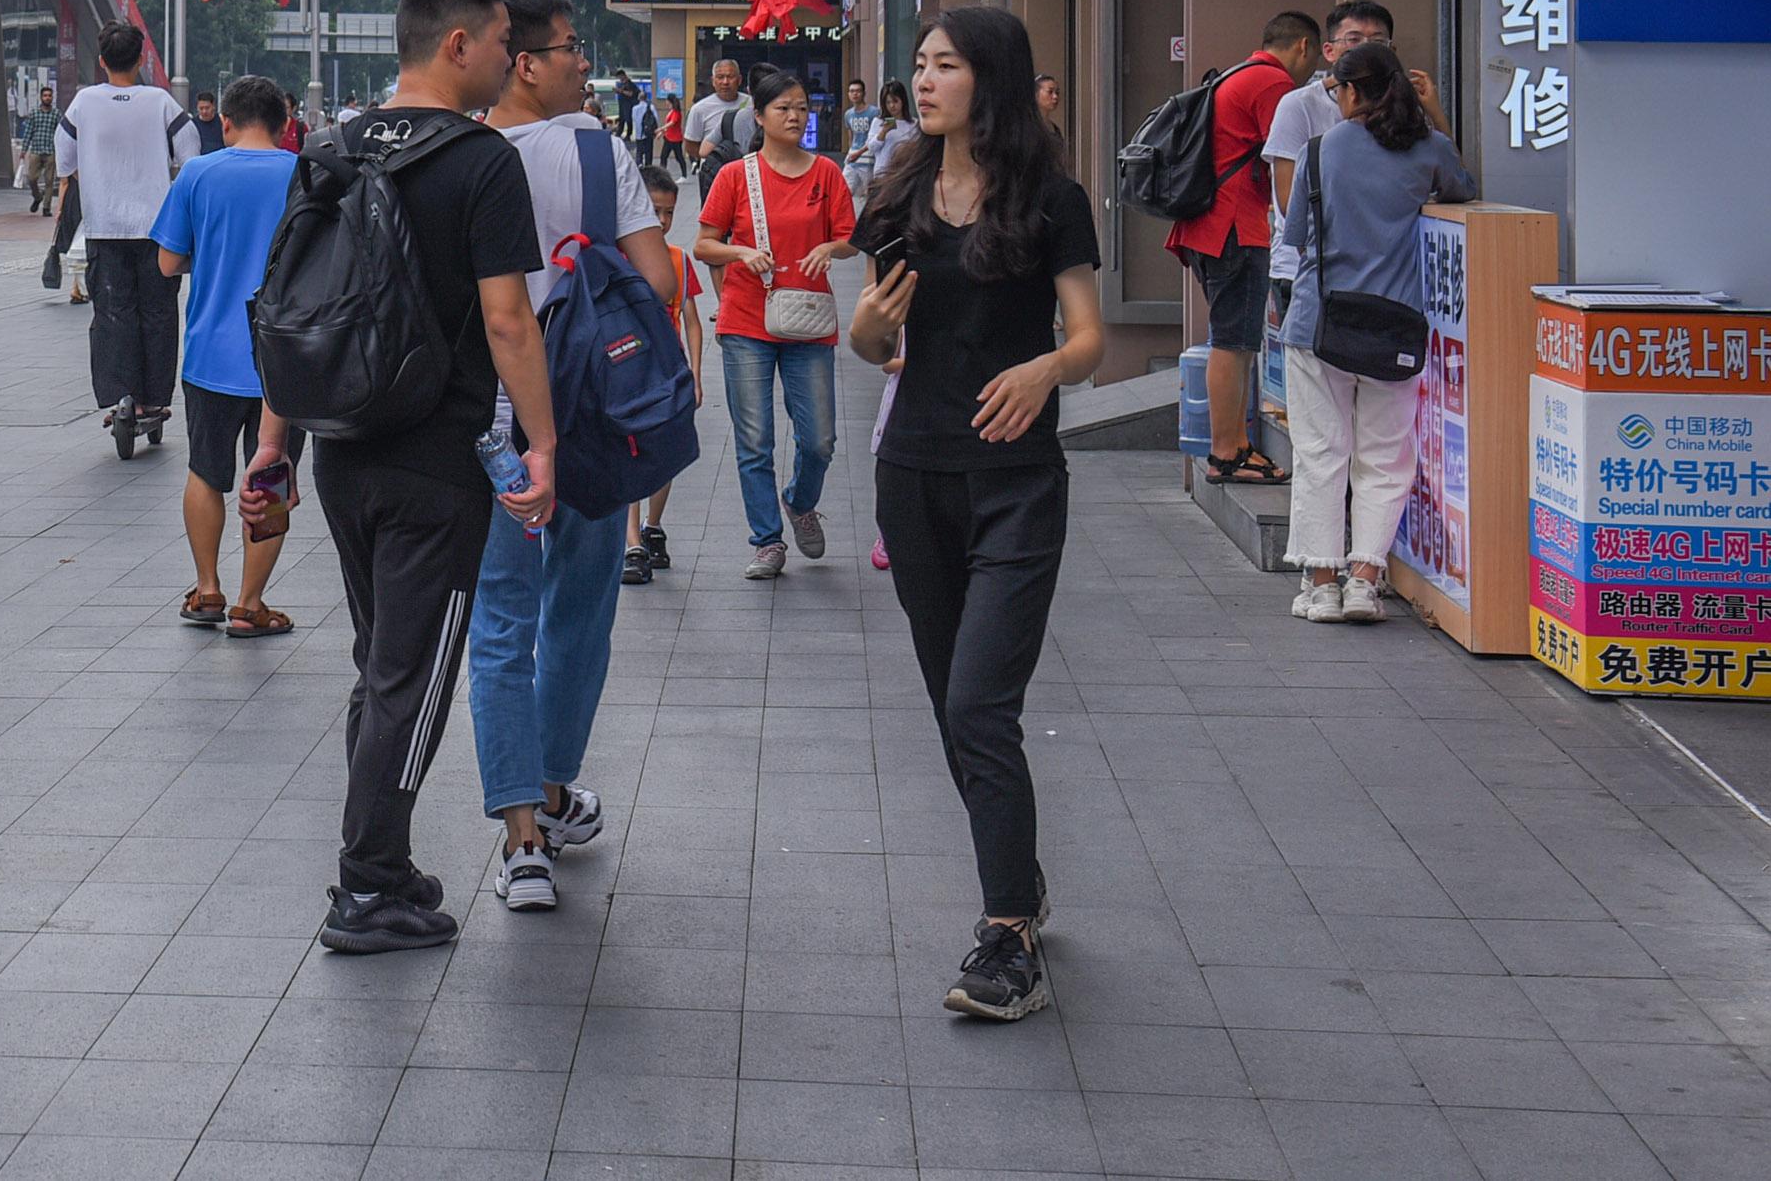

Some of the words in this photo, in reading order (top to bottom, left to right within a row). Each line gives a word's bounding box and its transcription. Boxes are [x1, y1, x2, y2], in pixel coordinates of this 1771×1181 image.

[1665, 415, 1752, 437] 中国移动
[1665, 437, 1705, 450] China
[1708, 438, 1753, 452] Mobile
[1536, 434, 1578, 487] 特价号码卡
[1599, 456, 1771, 496] 特价号码卡
[1598, 496, 1659, 518] Special
[1664, 499, 1731, 518] number
[1591, 564, 1646, 580] Speed
[1648, 566, 1673, 580] 4G
[1677, 567, 1741, 583] Internet
[1599, 590, 1681, 618] 路由器
[1693, 594, 1771, 621] 流量卡
[1621, 620, 1669, 633] Router
[1671, 622, 1716, 634] Traffic
[1719, 624, 1754, 636] Card
[1537, 615, 1580, 673] 免费开户
[1598, 643, 1771, 689] 免费开户
